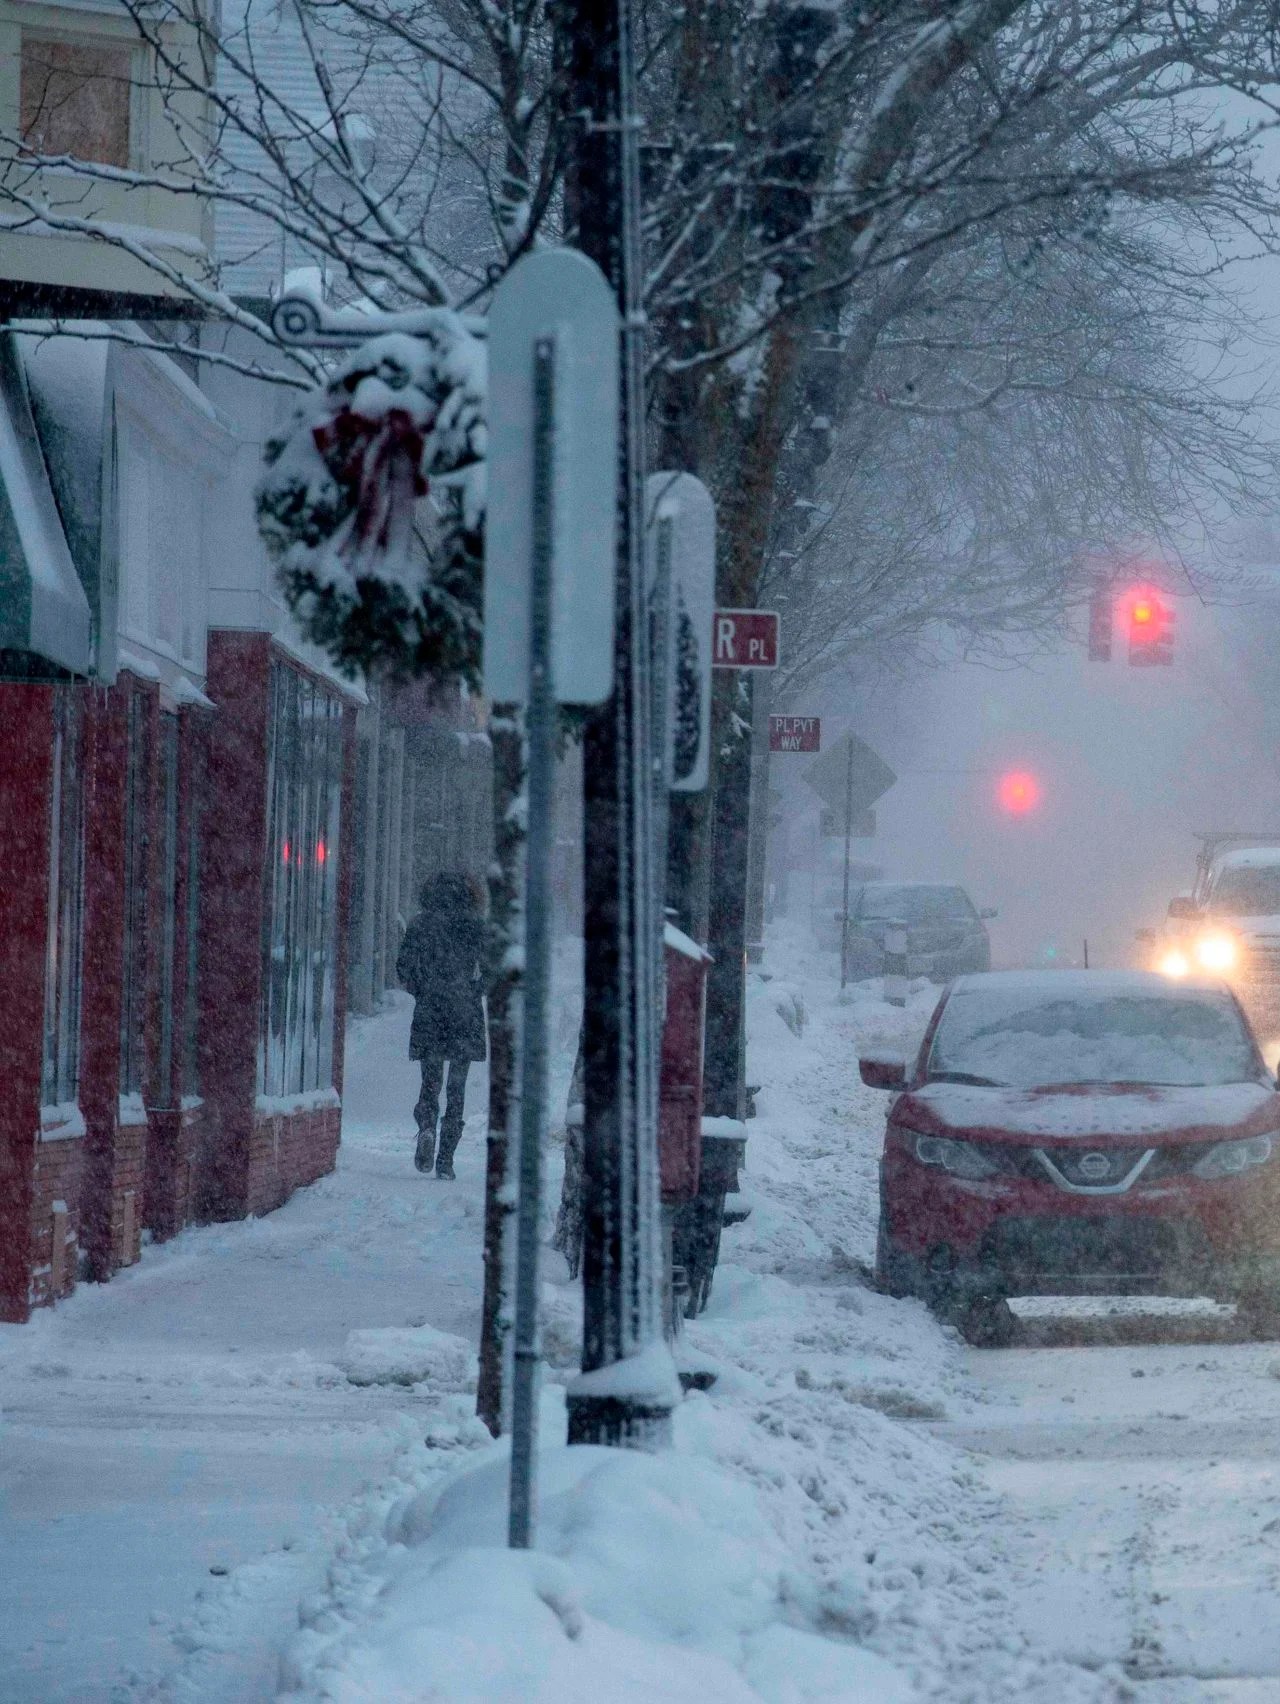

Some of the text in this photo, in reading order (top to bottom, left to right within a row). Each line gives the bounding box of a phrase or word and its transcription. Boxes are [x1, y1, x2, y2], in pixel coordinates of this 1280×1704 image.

[749, 638, 769, 661] PL
[775, 718, 816, 733] PL PVT
[781, 735, 802, 750] WAY
